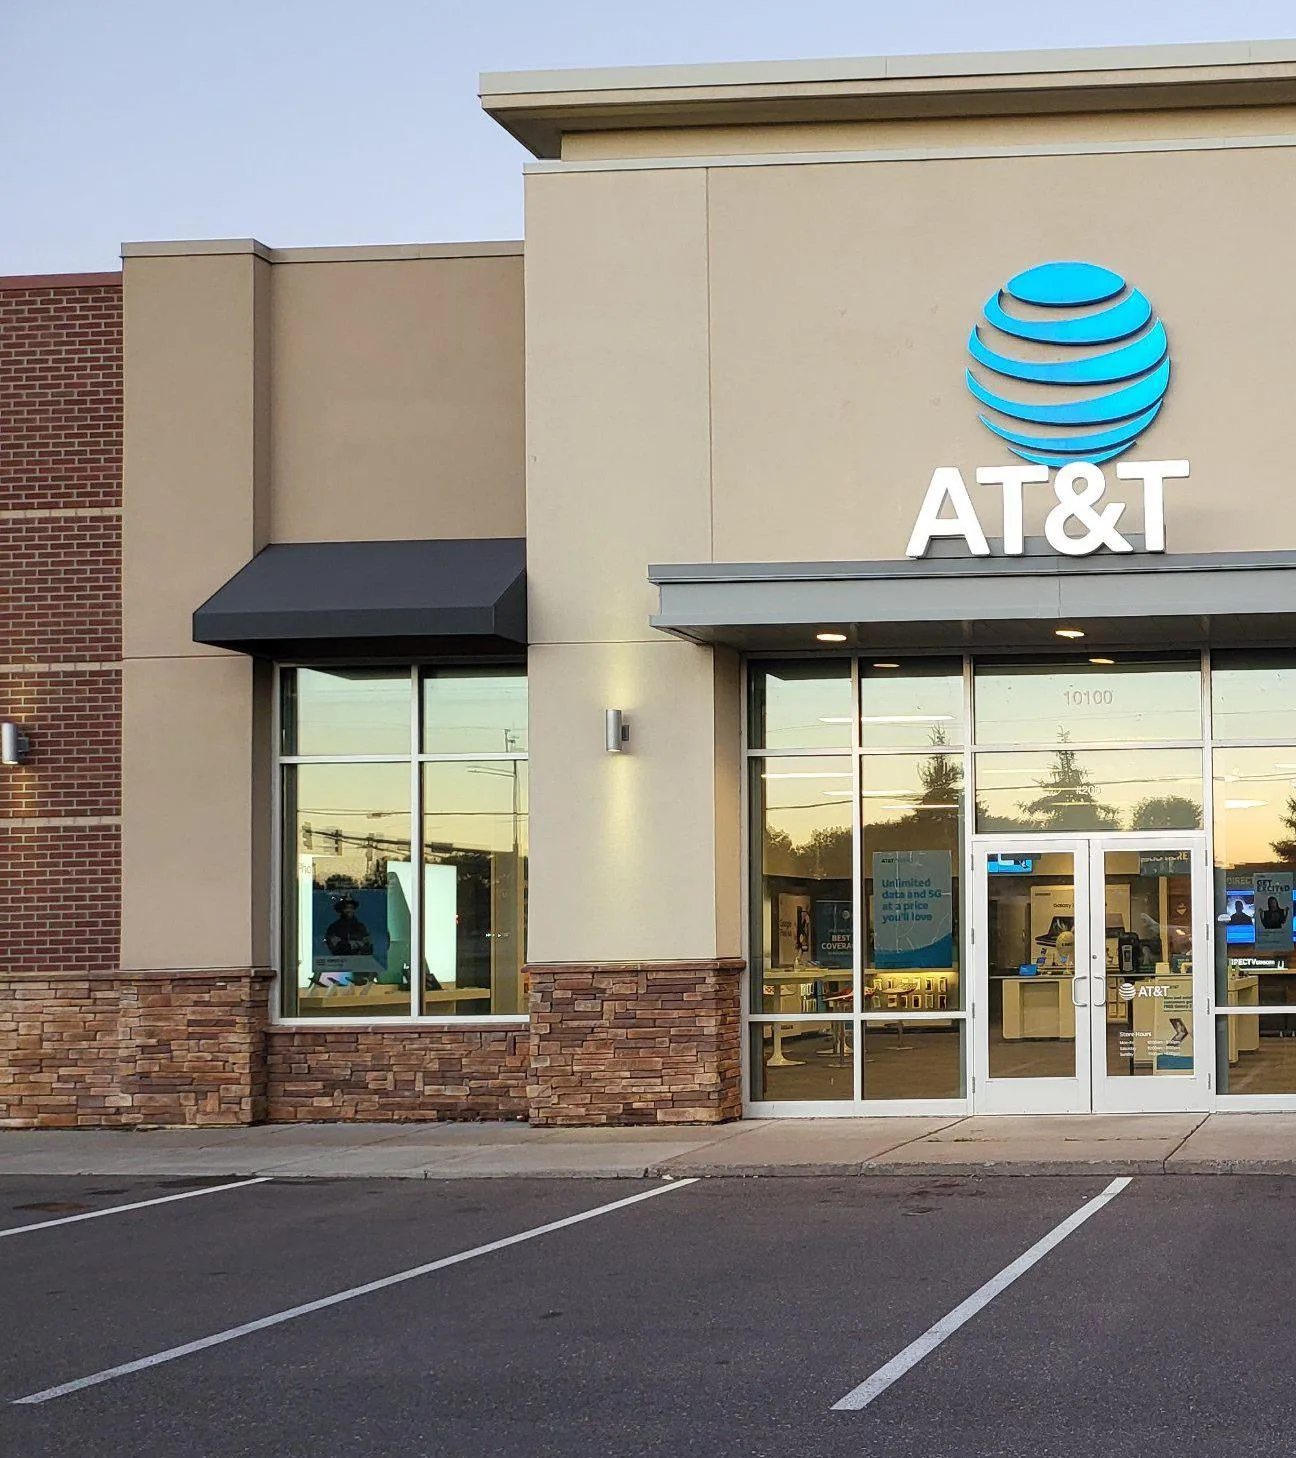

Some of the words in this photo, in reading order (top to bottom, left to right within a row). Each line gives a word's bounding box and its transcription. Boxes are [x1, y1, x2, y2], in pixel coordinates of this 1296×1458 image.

[905, 460, 1190, 557] AT&T
[1063, 690, 1113, 705] 10100
[882, 878, 931, 888] Unlimited
[882, 890, 905, 898] data
[907, 890, 926, 898] and
[928, 889, 942, 898] 5G
[882, 902, 893, 910] at
[903, 901, 929, 911] price
[882, 912, 909, 924] you'll
[911, 912, 933, 921] love
[832, 934, 851, 942] BEST
[821, 942, 853, 950] COVERA
[1138, 985, 1170, 997] AT&T
